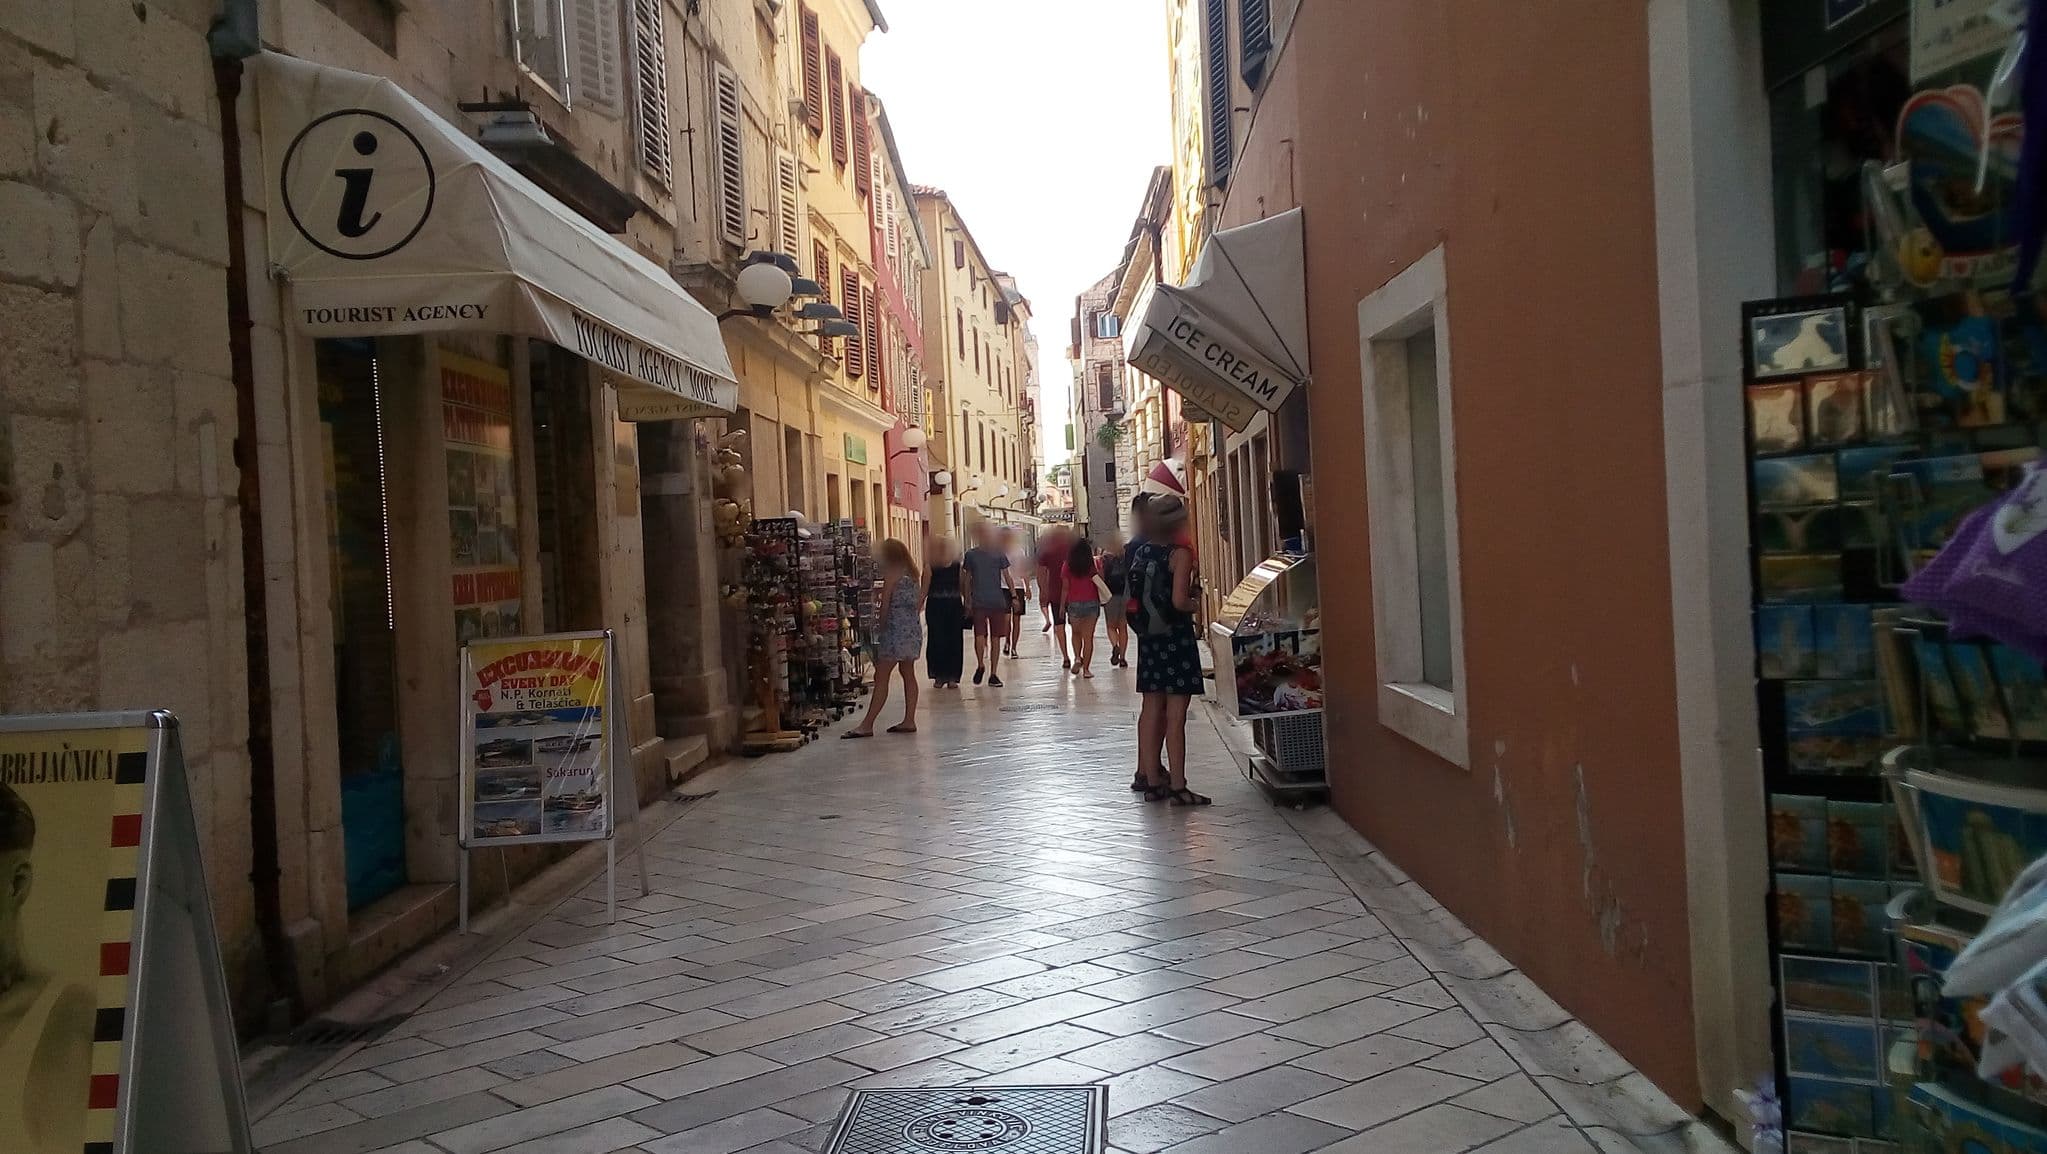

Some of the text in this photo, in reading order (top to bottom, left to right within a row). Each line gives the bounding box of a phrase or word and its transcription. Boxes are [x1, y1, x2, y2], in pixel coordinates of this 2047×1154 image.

[334, 131, 382, 238] i
[303, 304, 489, 323] TOURIST AGENCY
[572, 311, 632, 375] TOURIST
[638, 347, 682, 393] AGENCY
[1167, 315, 1279, 402] ICE CREAM
[501, 674, 576, 690] EVERY DAY
[529, 687, 571, 698] Kornati
[516, 700, 525, 710] &
